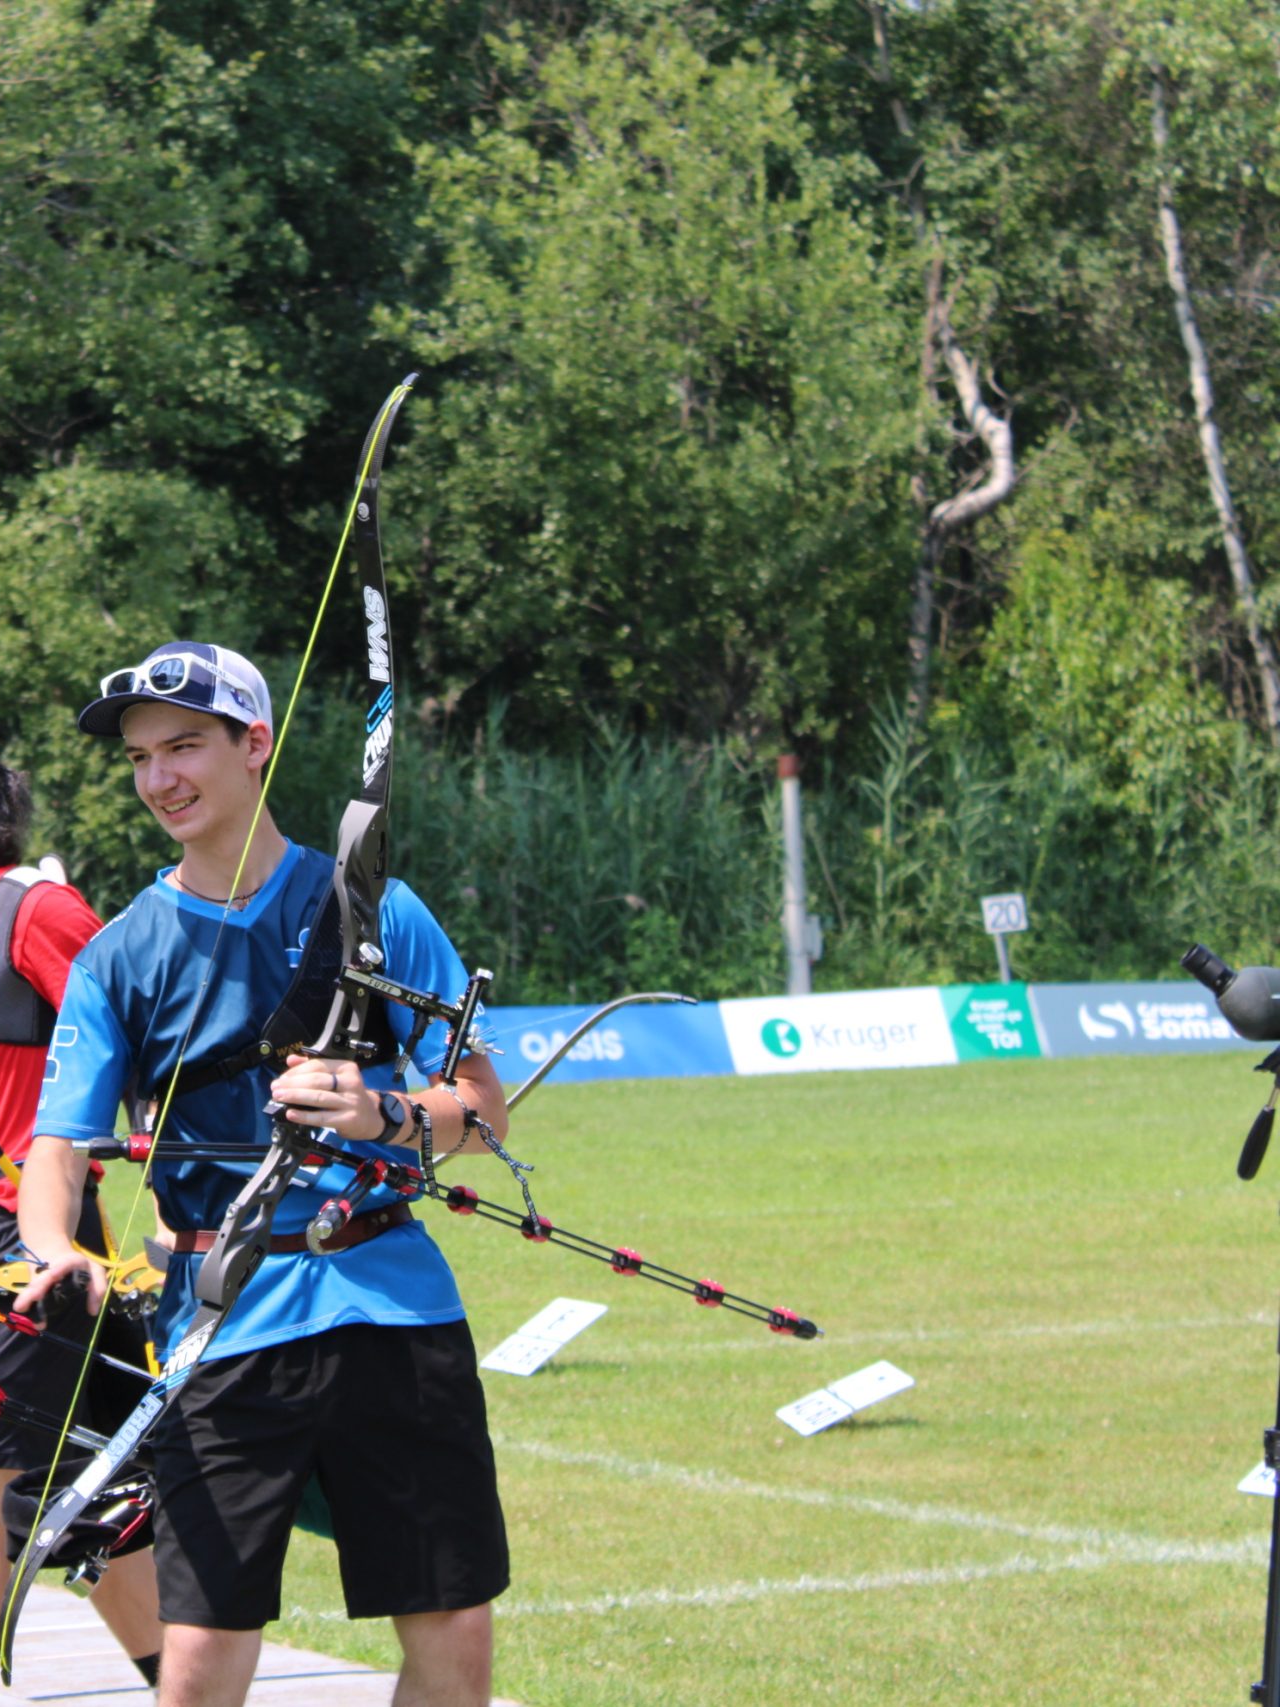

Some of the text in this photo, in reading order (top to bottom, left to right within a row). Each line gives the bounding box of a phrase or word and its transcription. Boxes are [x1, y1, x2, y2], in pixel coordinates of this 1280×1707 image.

[363, 585, 390, 682] WNS
[988, 900, 1023, 929] 20
[368, 978, 426, 1007] SURE LOC
[810, 1021, 919, 1051] Kruger
[1141, 1017, 1241, 1041] Soma
